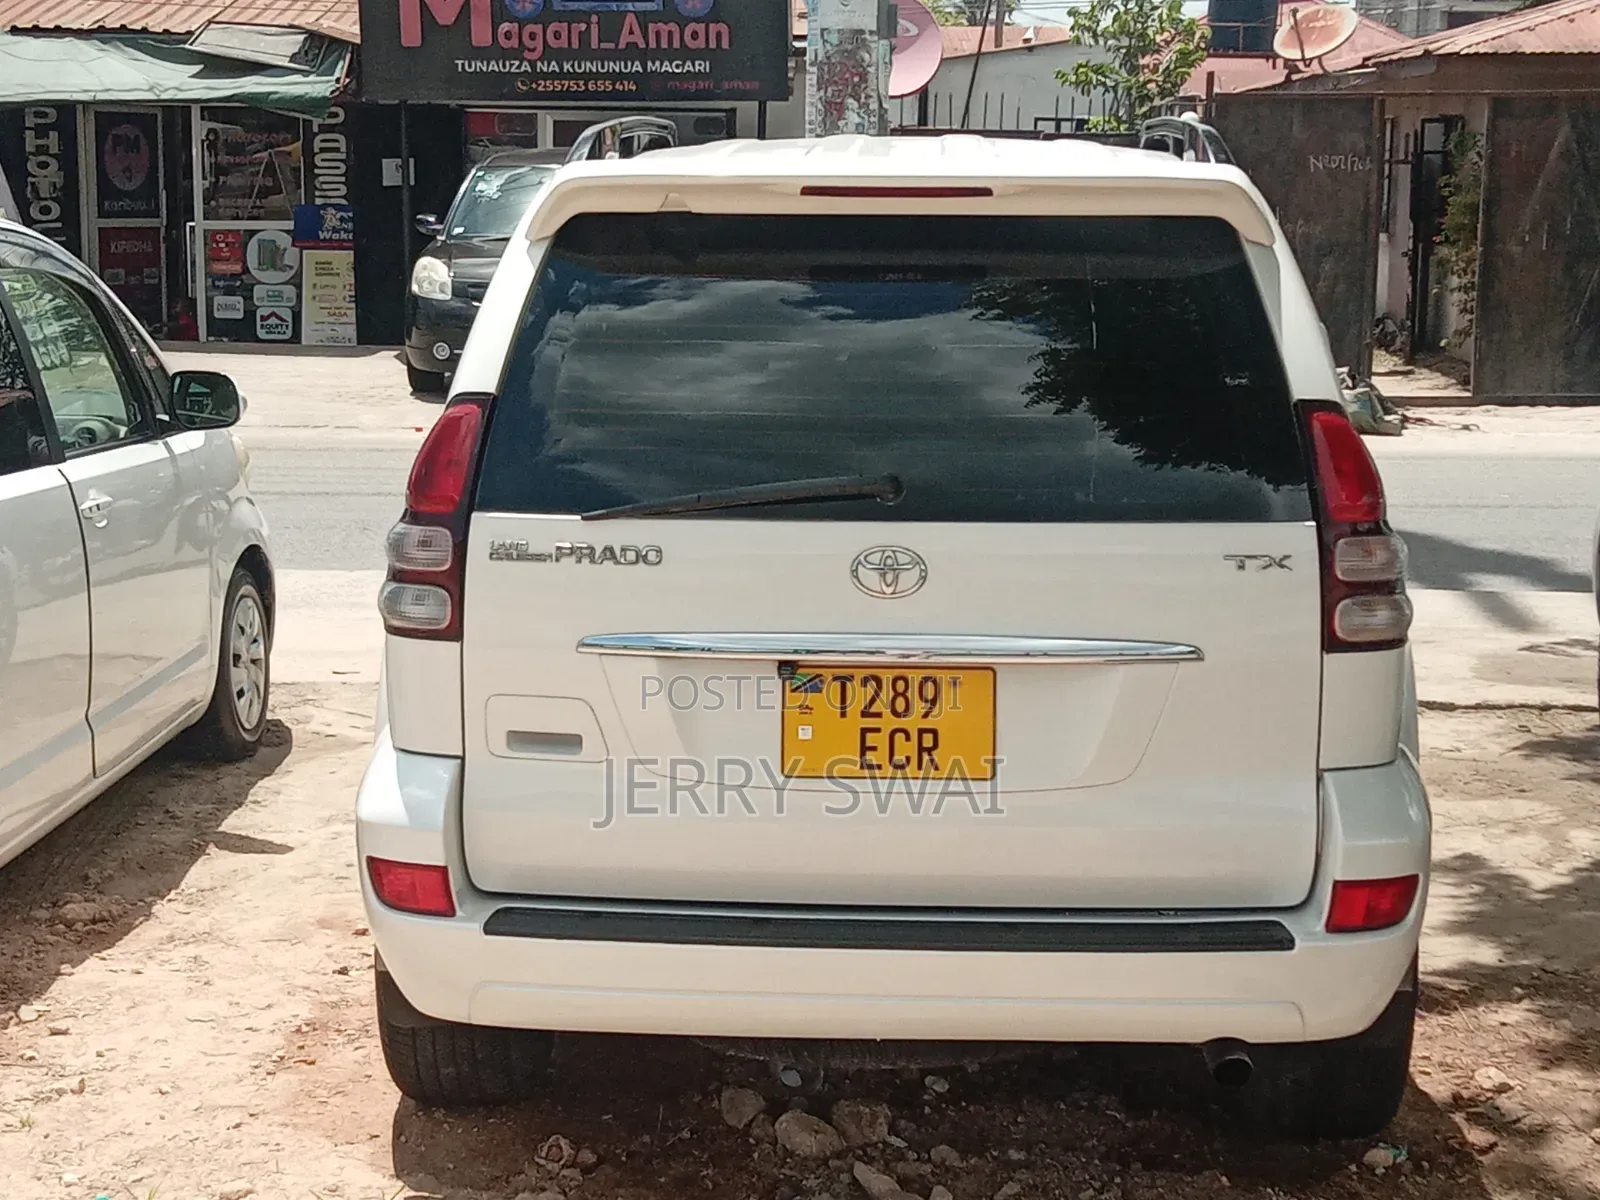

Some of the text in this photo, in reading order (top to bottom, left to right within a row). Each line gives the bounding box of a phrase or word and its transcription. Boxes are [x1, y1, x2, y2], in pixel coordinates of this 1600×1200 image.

[399, 0, 730, 60] Magari_Aman
[455, 60, 710, 73] TUNAUZA NA KUNUNUA MAGARI
[531, 79, 637, 92] +255753 655 414
[554, 541, 663, 565] PRADO
[1222, 554, 1294, 572] TX
[832, 674, 940, 719] T289
[859, 727, 940, 771] ECR
